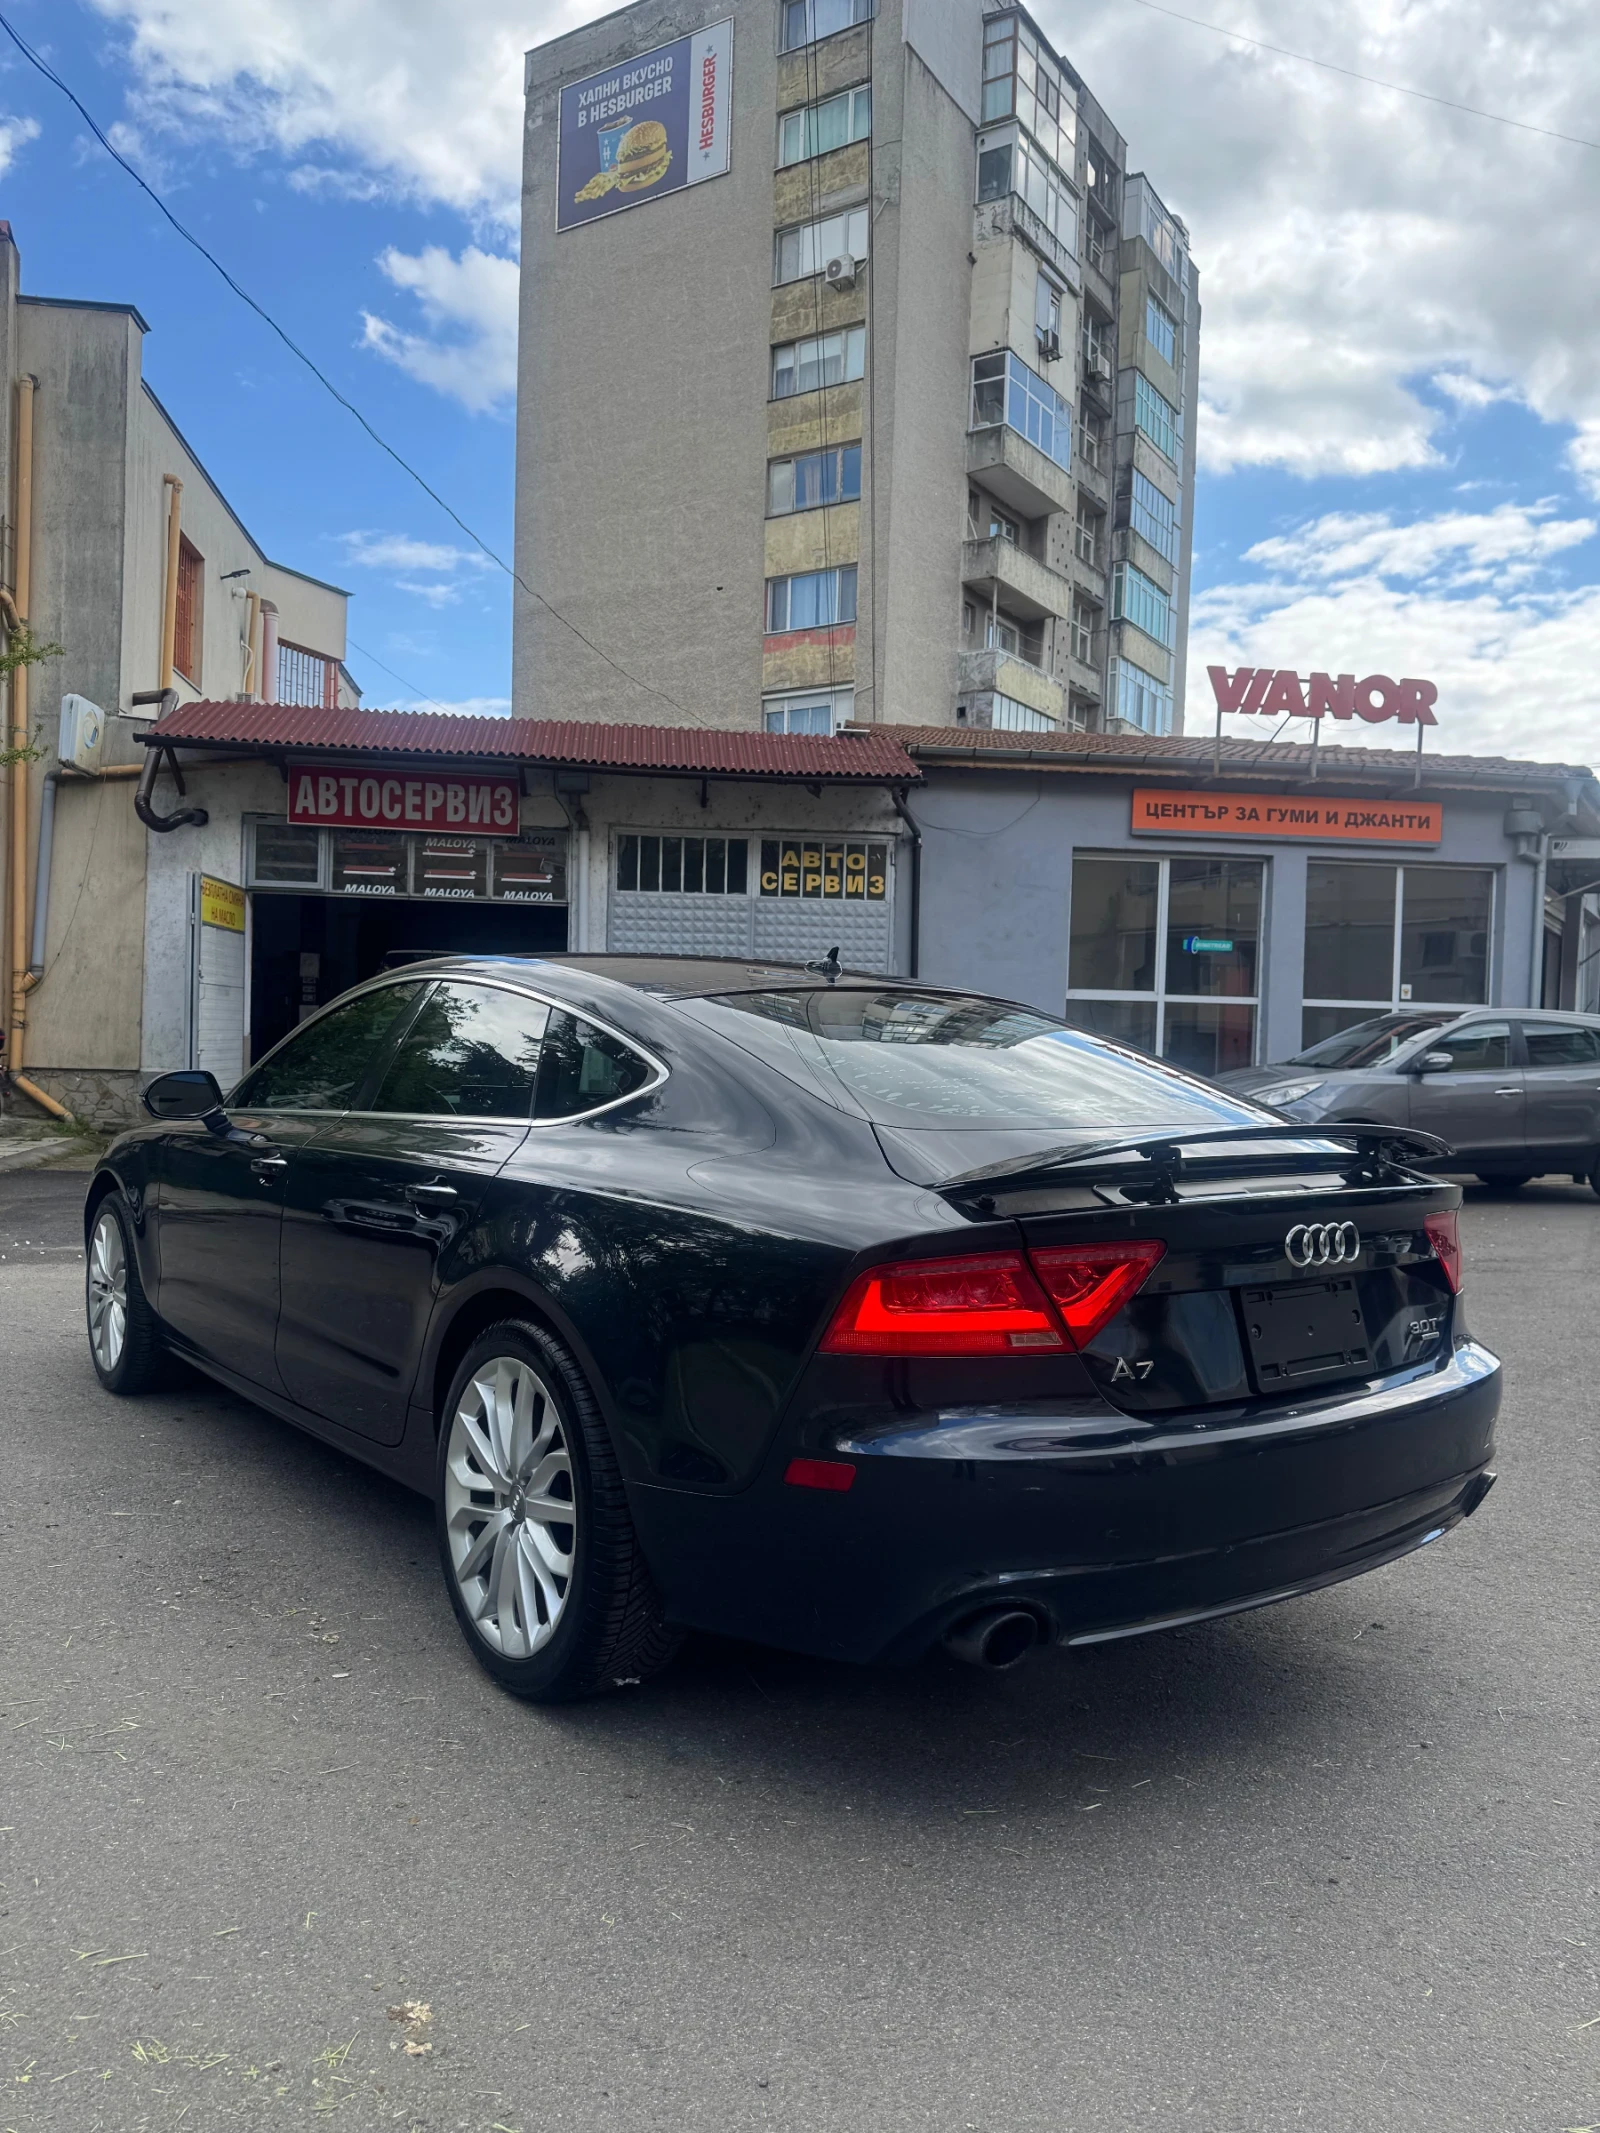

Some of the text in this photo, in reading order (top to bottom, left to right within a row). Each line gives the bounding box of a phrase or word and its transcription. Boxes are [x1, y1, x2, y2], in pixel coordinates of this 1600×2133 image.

[578, 56, 674, 108] ХАПНИ ВКУСНО
[590, 76, 672, 124] HESBURGER
[699, 53, 717, 151] HESBURGER
[1207, 665, 1439, 726] VIANOR
[294, 775, 514, 826] АВТОСЕРВИЗ
[1145, 802, 1431, 829] ЦЕНТЪР ЗА ГУМИ И ДЖАНТИ
[425, 837, 477, 849] MALOYA
[781, 850, 866, 870] АВТО
[344, 883, 396, 895] MALOYA
[424, 887, 475, 898] MALOYA
[503, 890, 553, 901] MALOYA
[761, 872, 885, 894] СЕРВИЗ
[1111, 1356, 1155, 1383] A7
